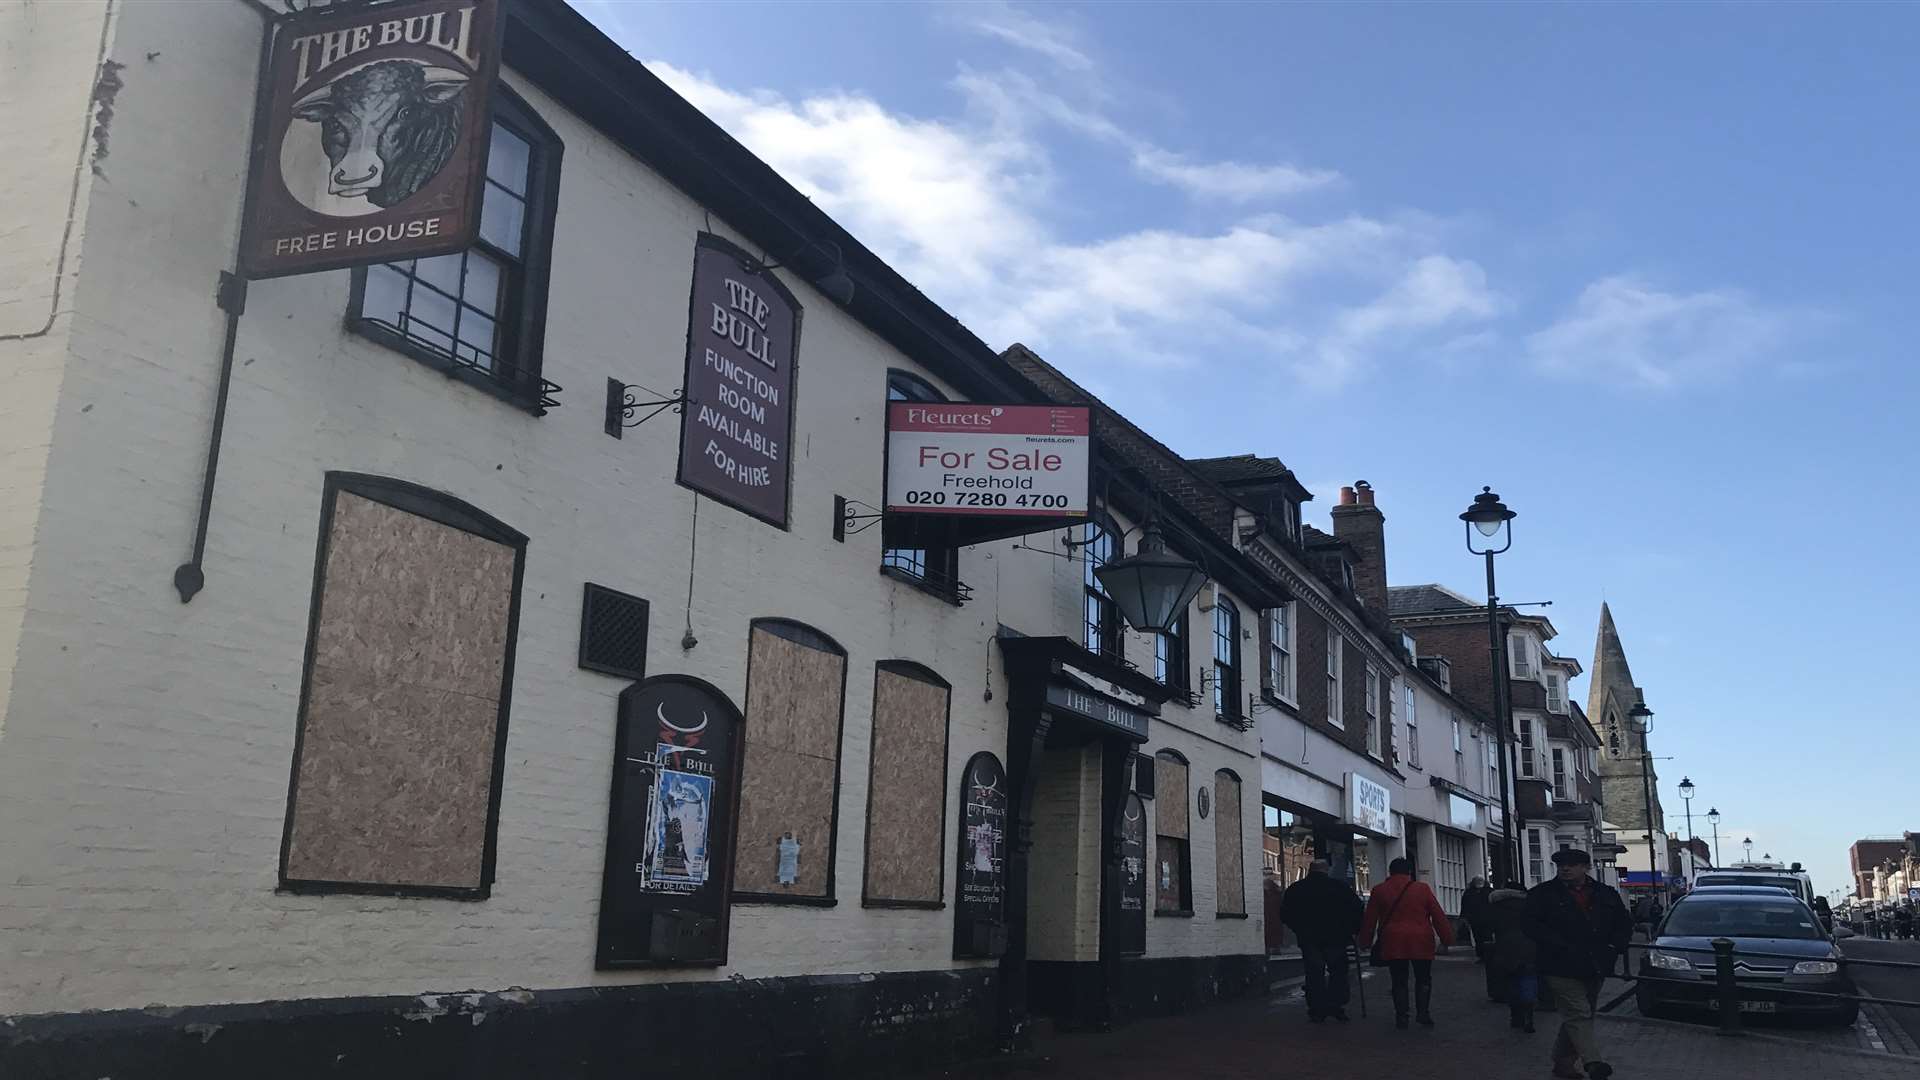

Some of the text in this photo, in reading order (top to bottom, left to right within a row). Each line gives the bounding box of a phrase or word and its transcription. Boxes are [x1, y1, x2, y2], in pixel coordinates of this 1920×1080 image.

[291, 7, 480, 94] THE BULL
[275, 218, 440, 256] FREE HOUSE
[724, 278, 770, 330] THE
[711, 303, 777, 368] BULL
[705, 348, 778, 406] FUNCTION
[718, 383, 765, 425] ROOM
[908, 409, 992, 426] Fleurets
[698, 405, 778, 461] AVAILABLE
[1026, 436, 1075, 444] fleurets.com
[705, 440, 771, 486] FOR HIRE
[919, 446, 1062, 472] For Sale
[906, 491, 1068, 508] 020 7280 4700
[943, 474, 1033, 489] Freehold
[1065, 688, 1137, 730] THE BULL
[1360, 780, 1385, 813] SPORTS
